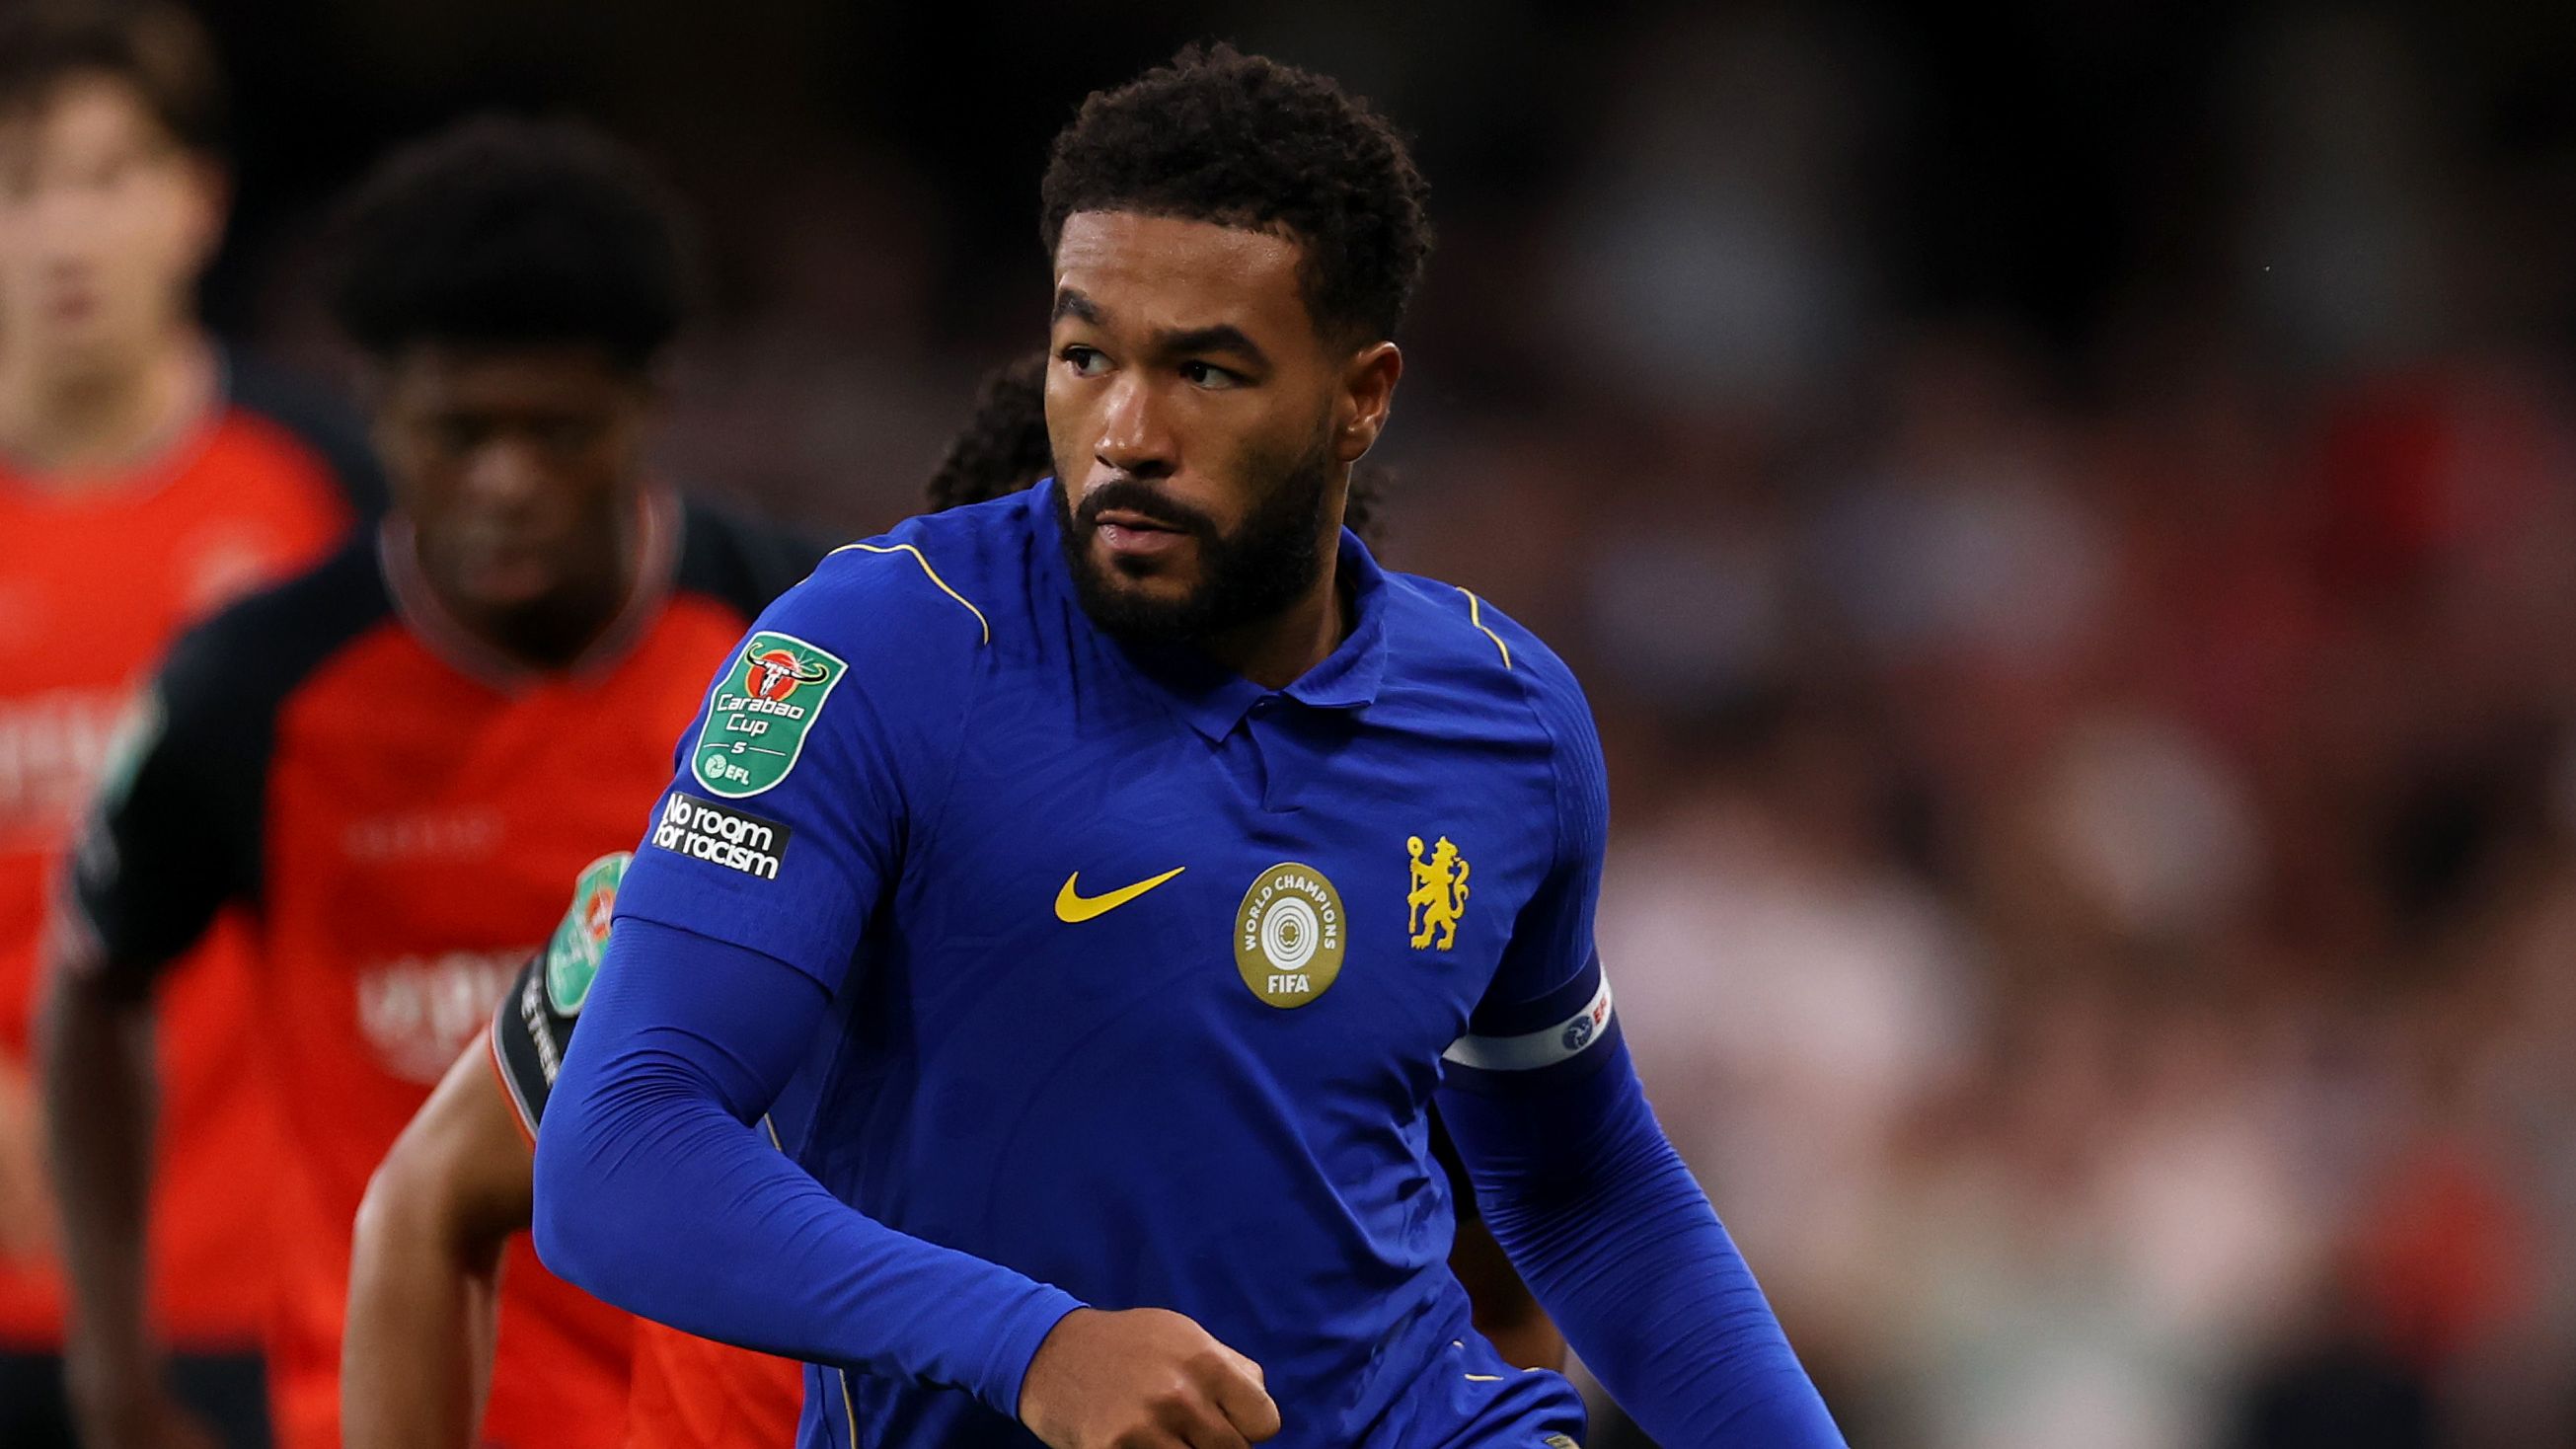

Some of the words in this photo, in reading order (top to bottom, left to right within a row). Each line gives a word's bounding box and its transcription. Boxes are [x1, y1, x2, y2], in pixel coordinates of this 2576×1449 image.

[718, 693, 804, 720] Carabao
[726, 714, 768, 736] Cup
[725, 766, 750, 786] EFL
[663, 794, 691, 824] No
[692, 806, 773, 851] room
[652, 817, 685, 850] for
[682, 829, 779, 879] racism
[1245, 885, 1272, 951] WORLD
[1275, 875, 1336, 949] CHAMPIONS
[1267, 974, 1309, 993] FIFA
